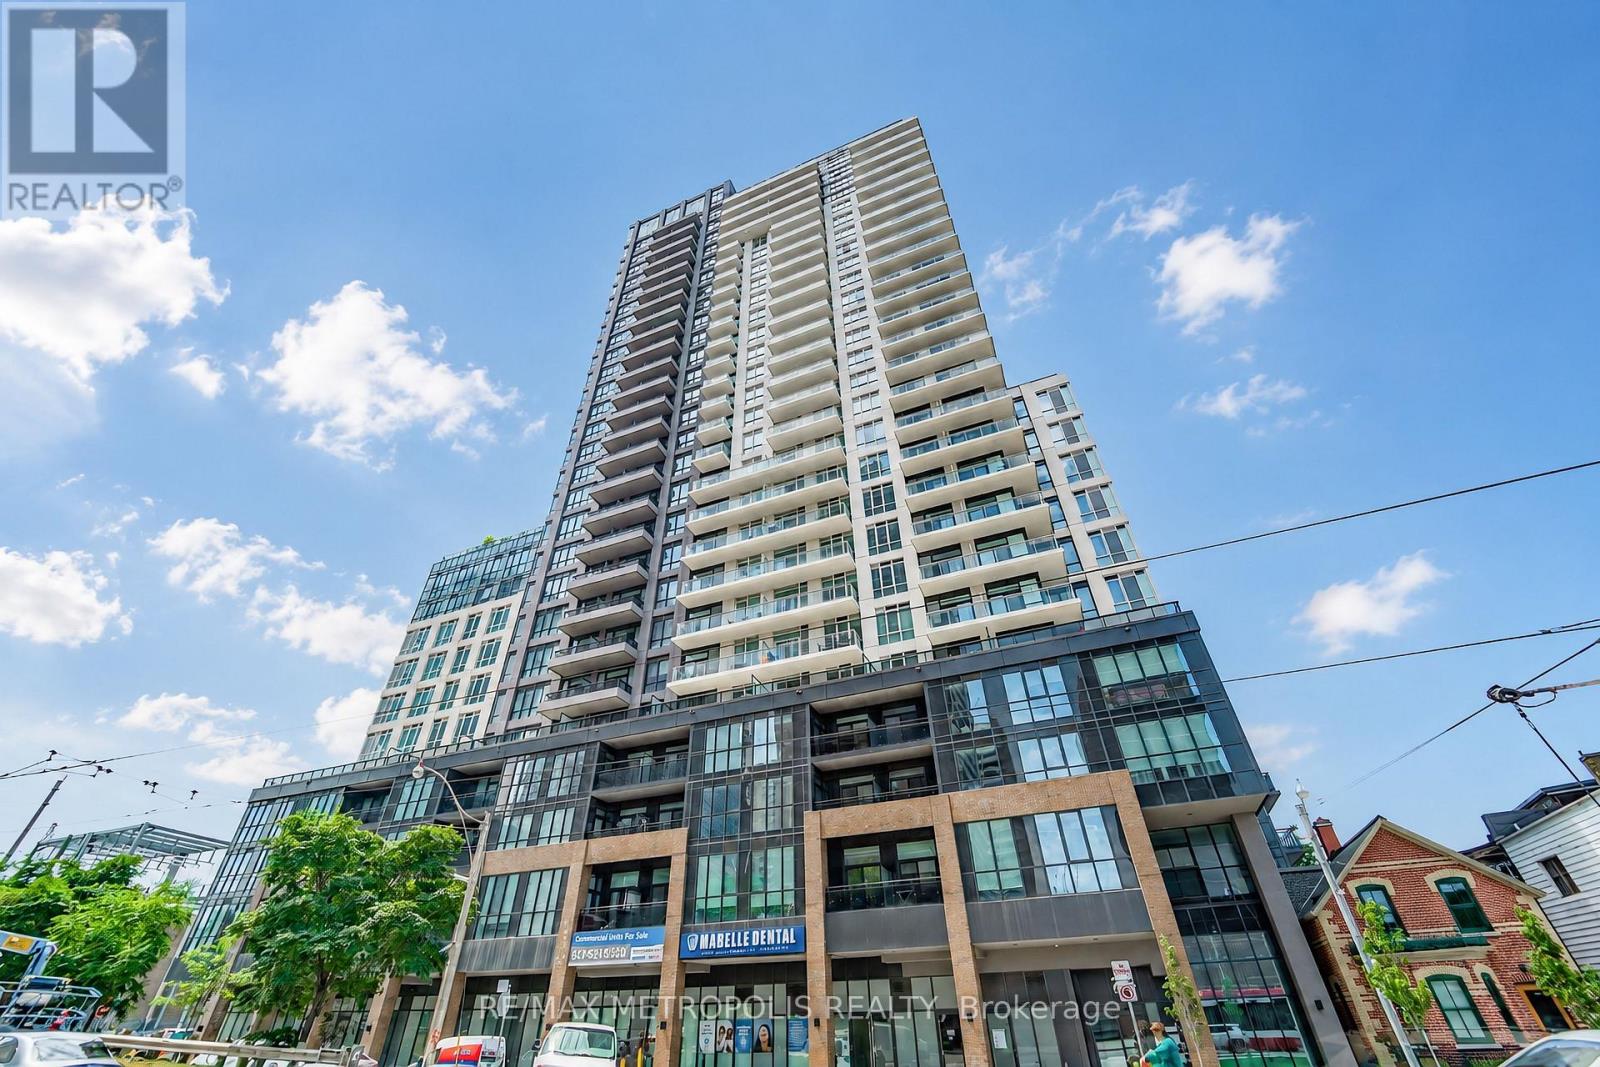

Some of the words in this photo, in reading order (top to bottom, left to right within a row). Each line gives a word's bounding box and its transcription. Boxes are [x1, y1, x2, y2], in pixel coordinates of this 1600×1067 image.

[575, 933, 609, 942] Commercial
[625, 932, 635, 940] For
[636, 931, 649, 939] Sale
[700, 931, 749, 950] MABELLE
[752, 927, 796, 946] DENTAL
